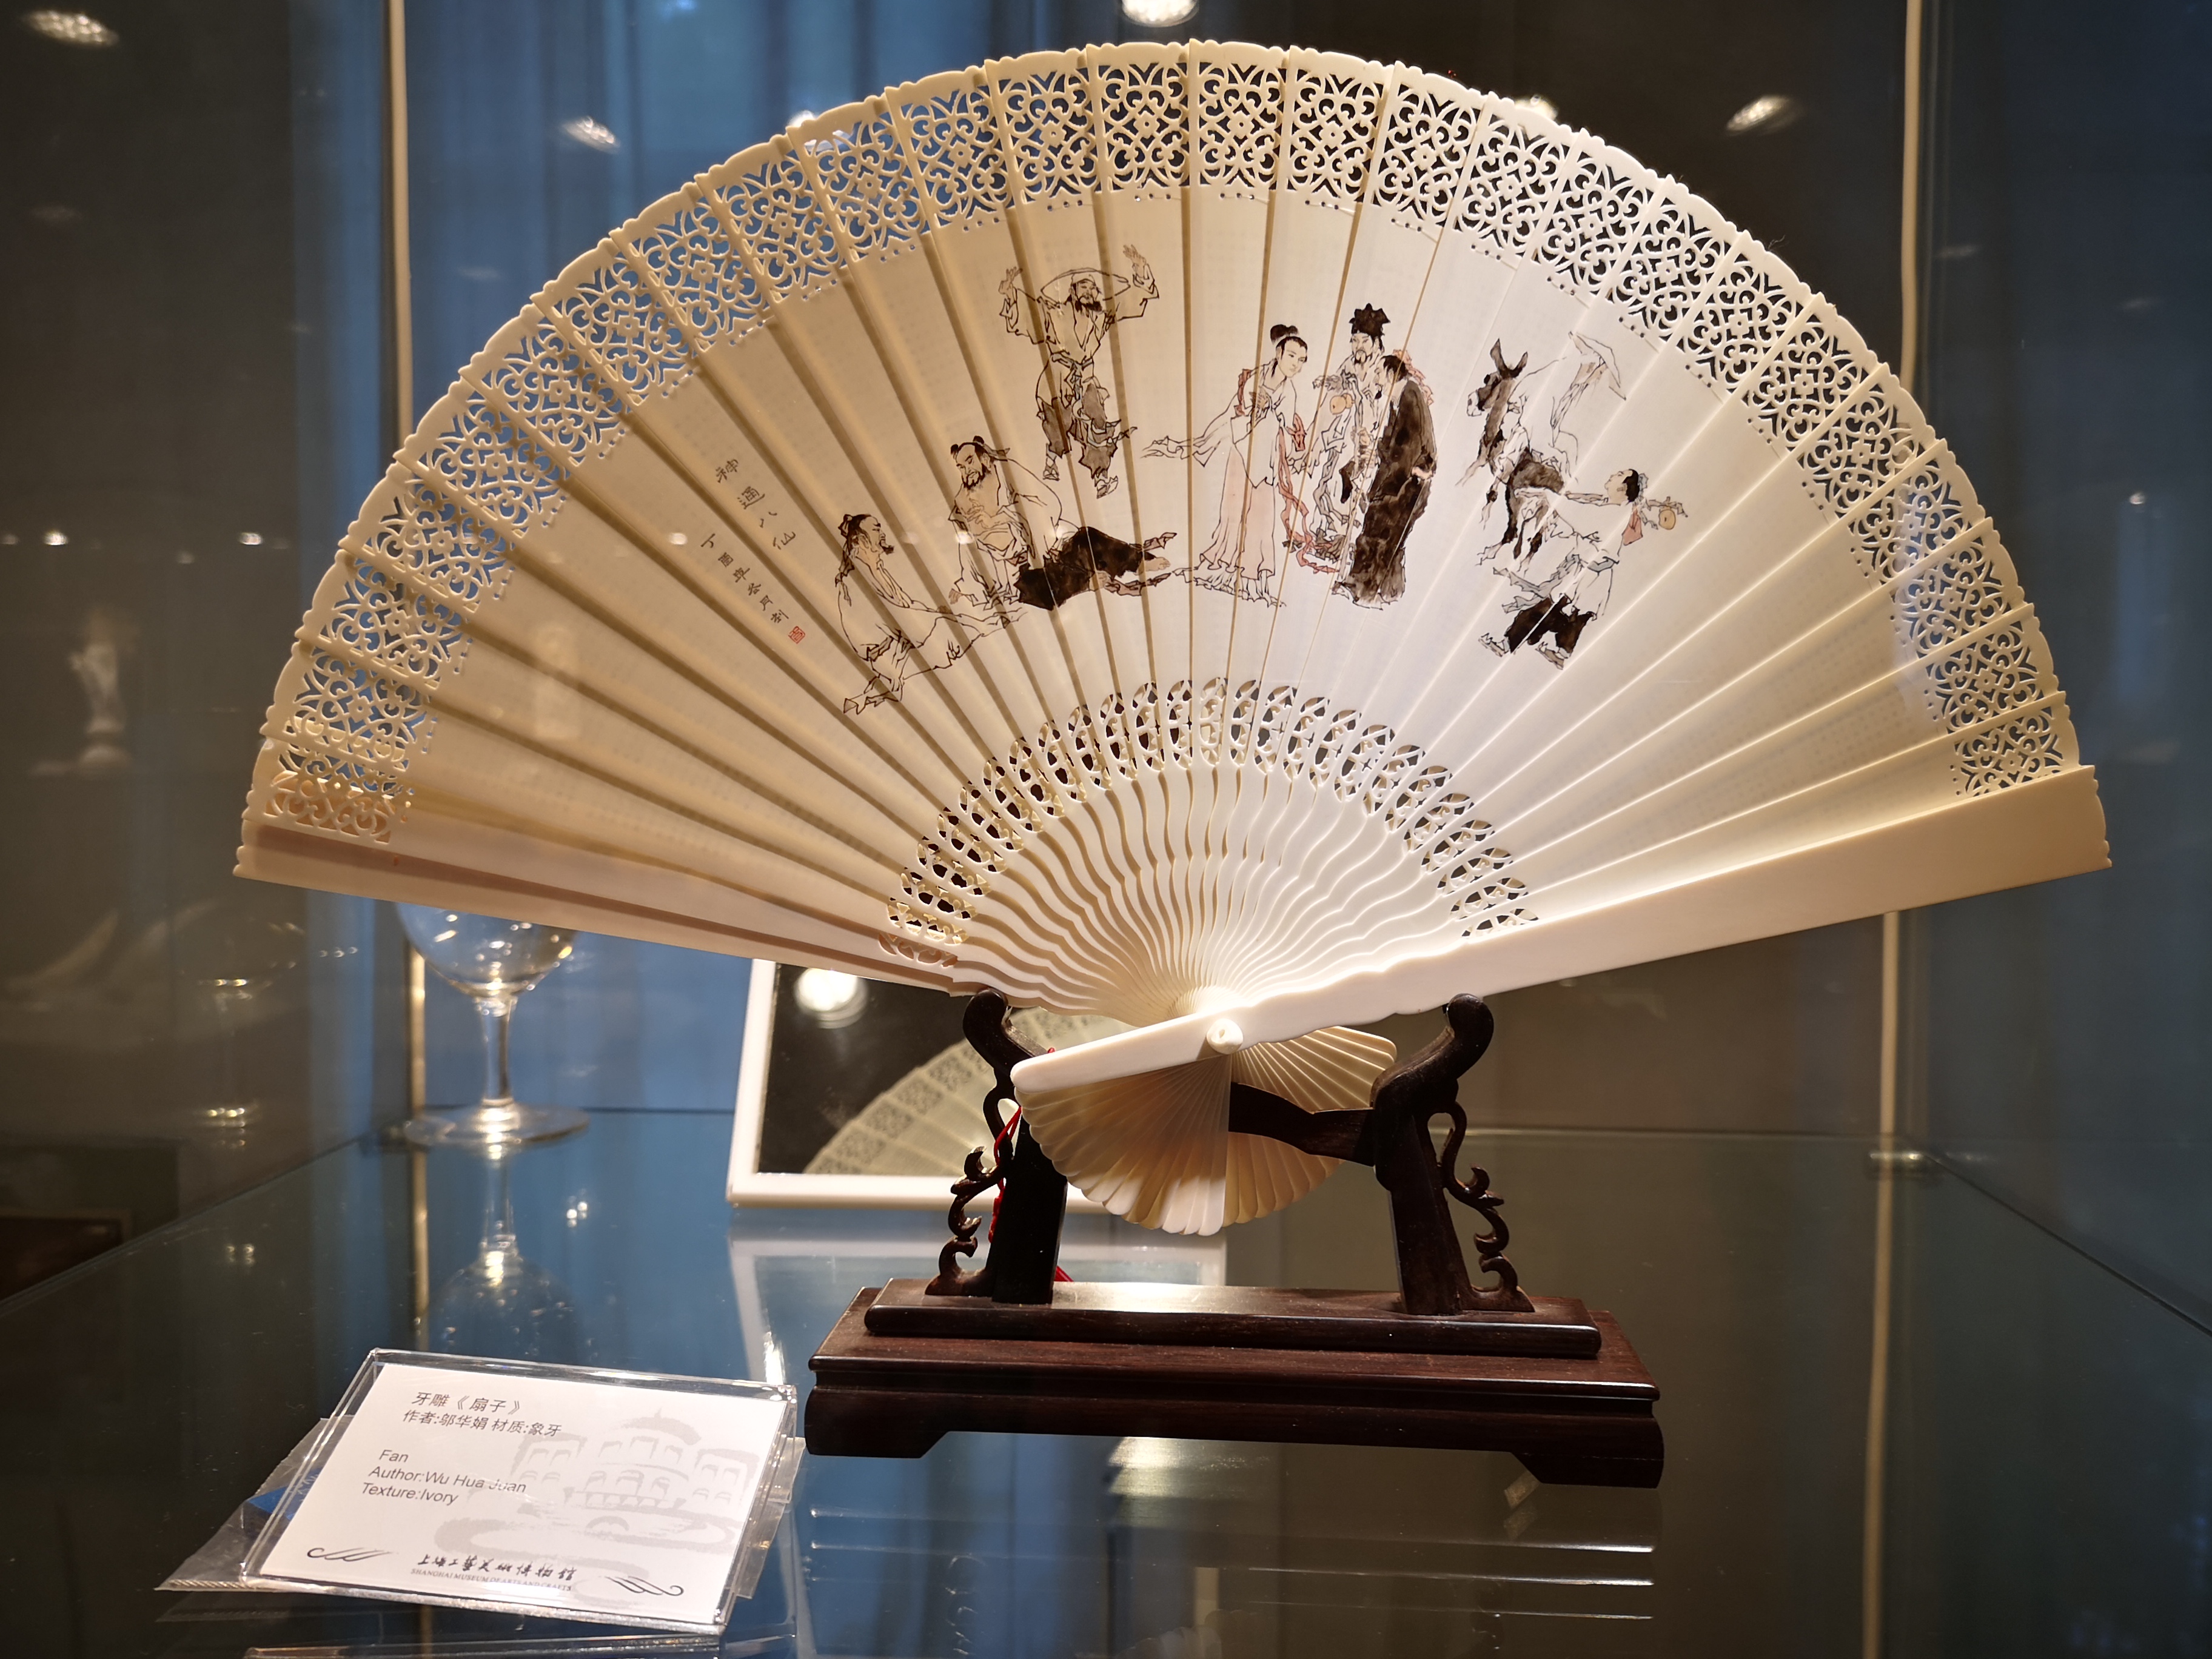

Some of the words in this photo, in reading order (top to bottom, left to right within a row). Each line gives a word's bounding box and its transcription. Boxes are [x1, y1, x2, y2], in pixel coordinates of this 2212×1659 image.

[378, 1449, 409, 1463] Fan
[367, 1466, 450, 1485] Author:Wu
[455, 1474, 484, 1489] Hua
[489, 1478, 527, 1493] Juan
[361, 1482, 459, 1506] Texture:Ivory
[411, 1567, 453, 1579] SHANGHAI
[453, 1573, 489, 1583] MUSEUM
